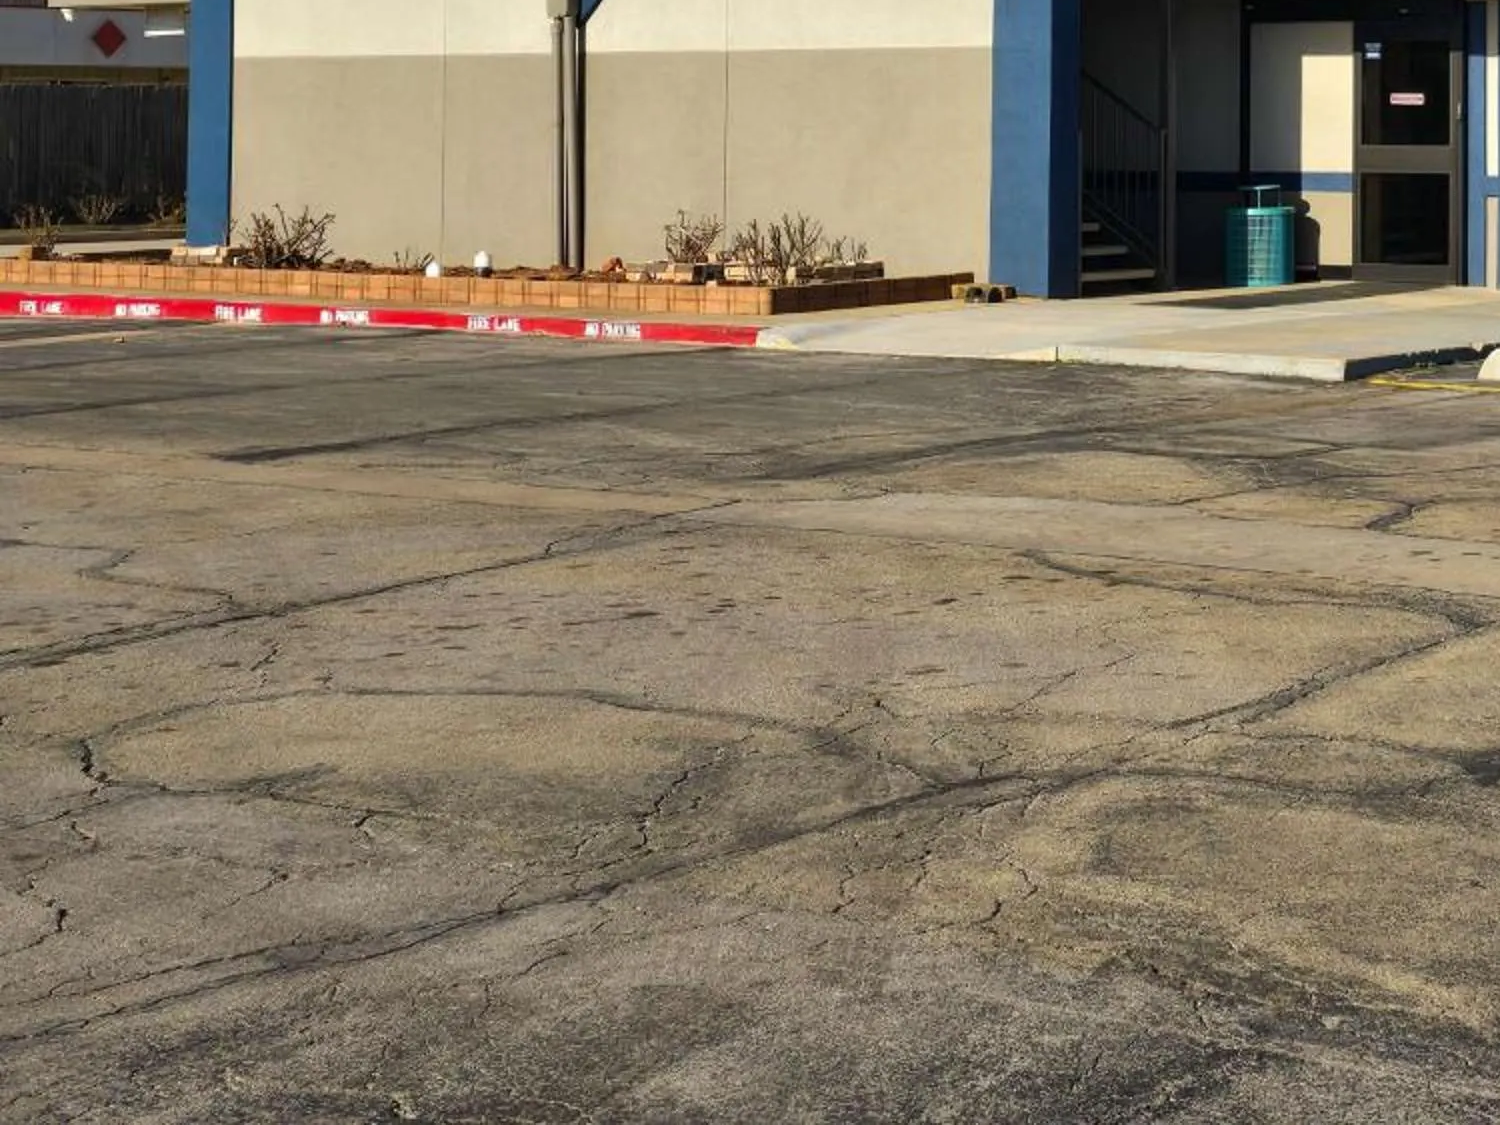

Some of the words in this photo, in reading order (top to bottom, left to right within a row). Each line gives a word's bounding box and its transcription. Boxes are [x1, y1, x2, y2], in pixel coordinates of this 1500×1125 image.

[215, 304, 235, 321] FIRE
[237, 306, 262, 322] LANE
[467, 315, 491, 331] FIRE
[493, 317, 521, 332] LANE
[584, 321, 599, 337] NO
[601, 322, 641, 338] PARKING
